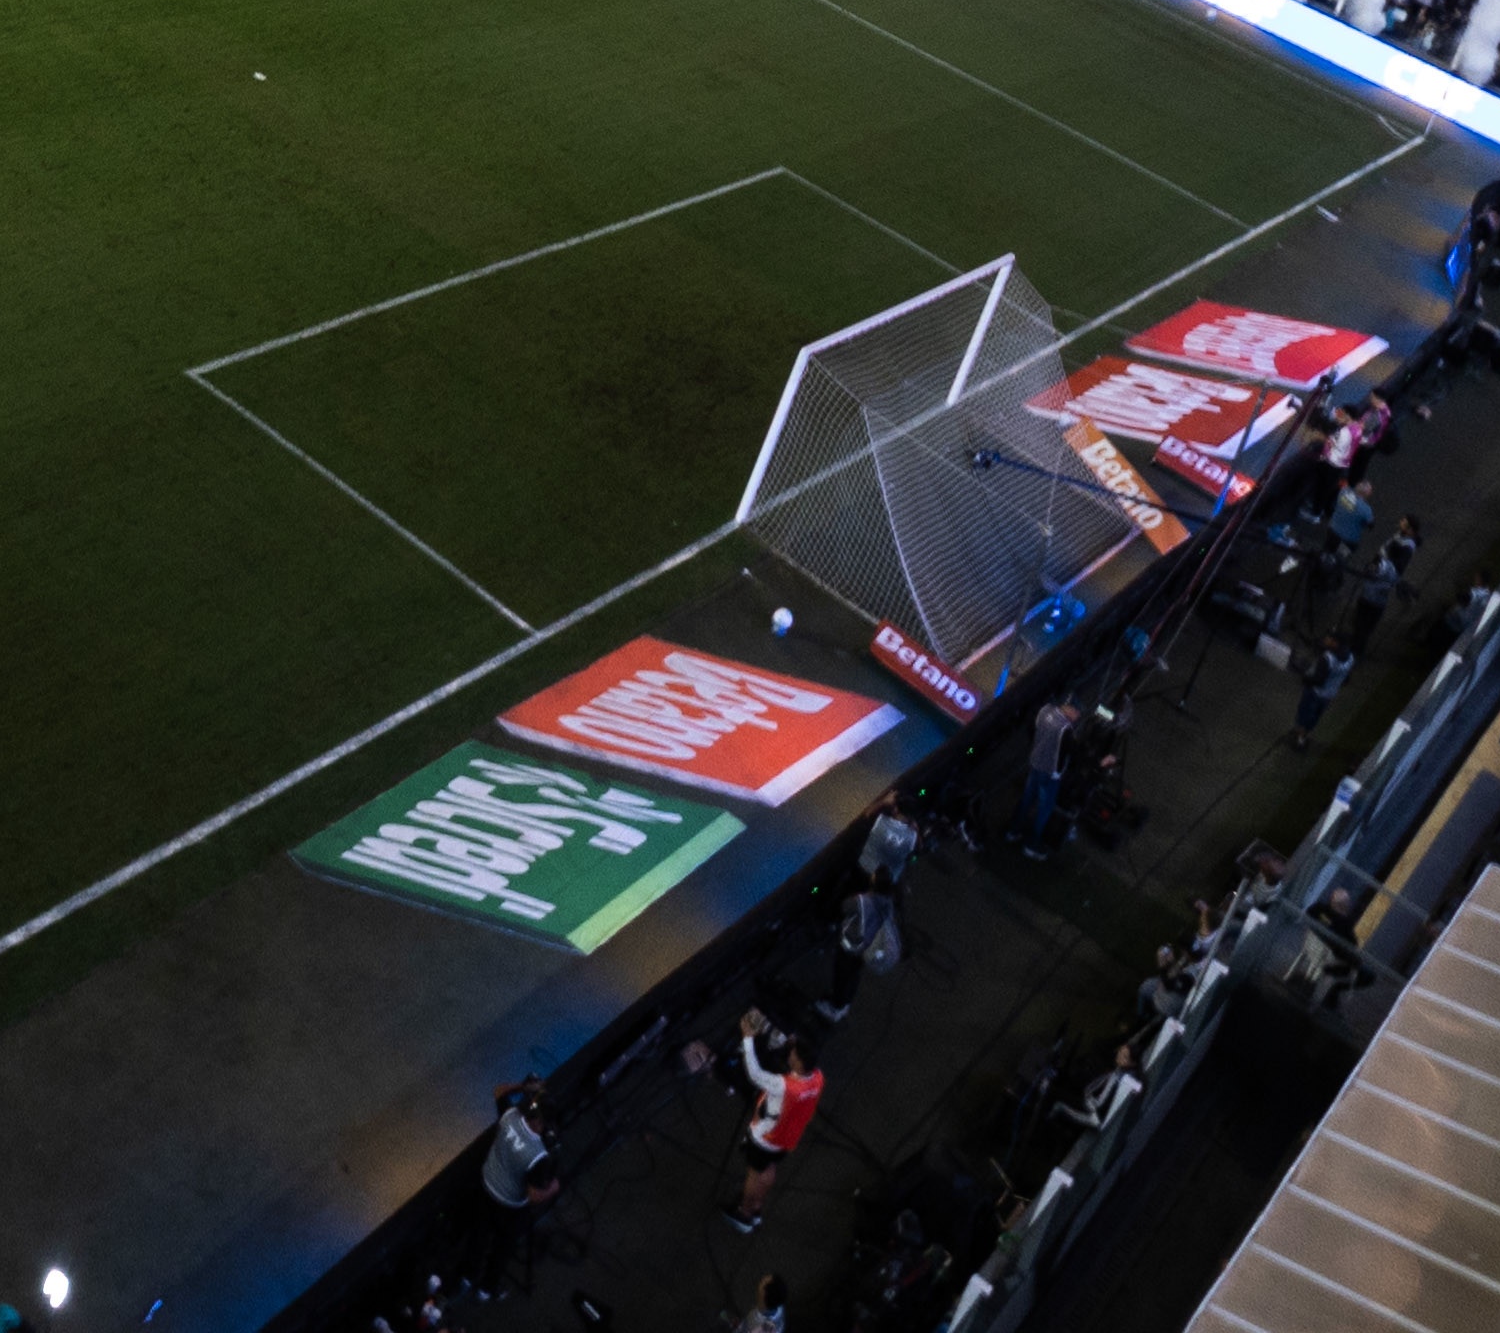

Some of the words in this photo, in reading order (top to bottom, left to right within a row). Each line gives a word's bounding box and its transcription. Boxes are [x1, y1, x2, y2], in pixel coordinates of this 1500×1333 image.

[558, 651, 833, 761] Betano
[875, 626, 976, 711] Betano
[341, 775, 648, 919] Sicredi
